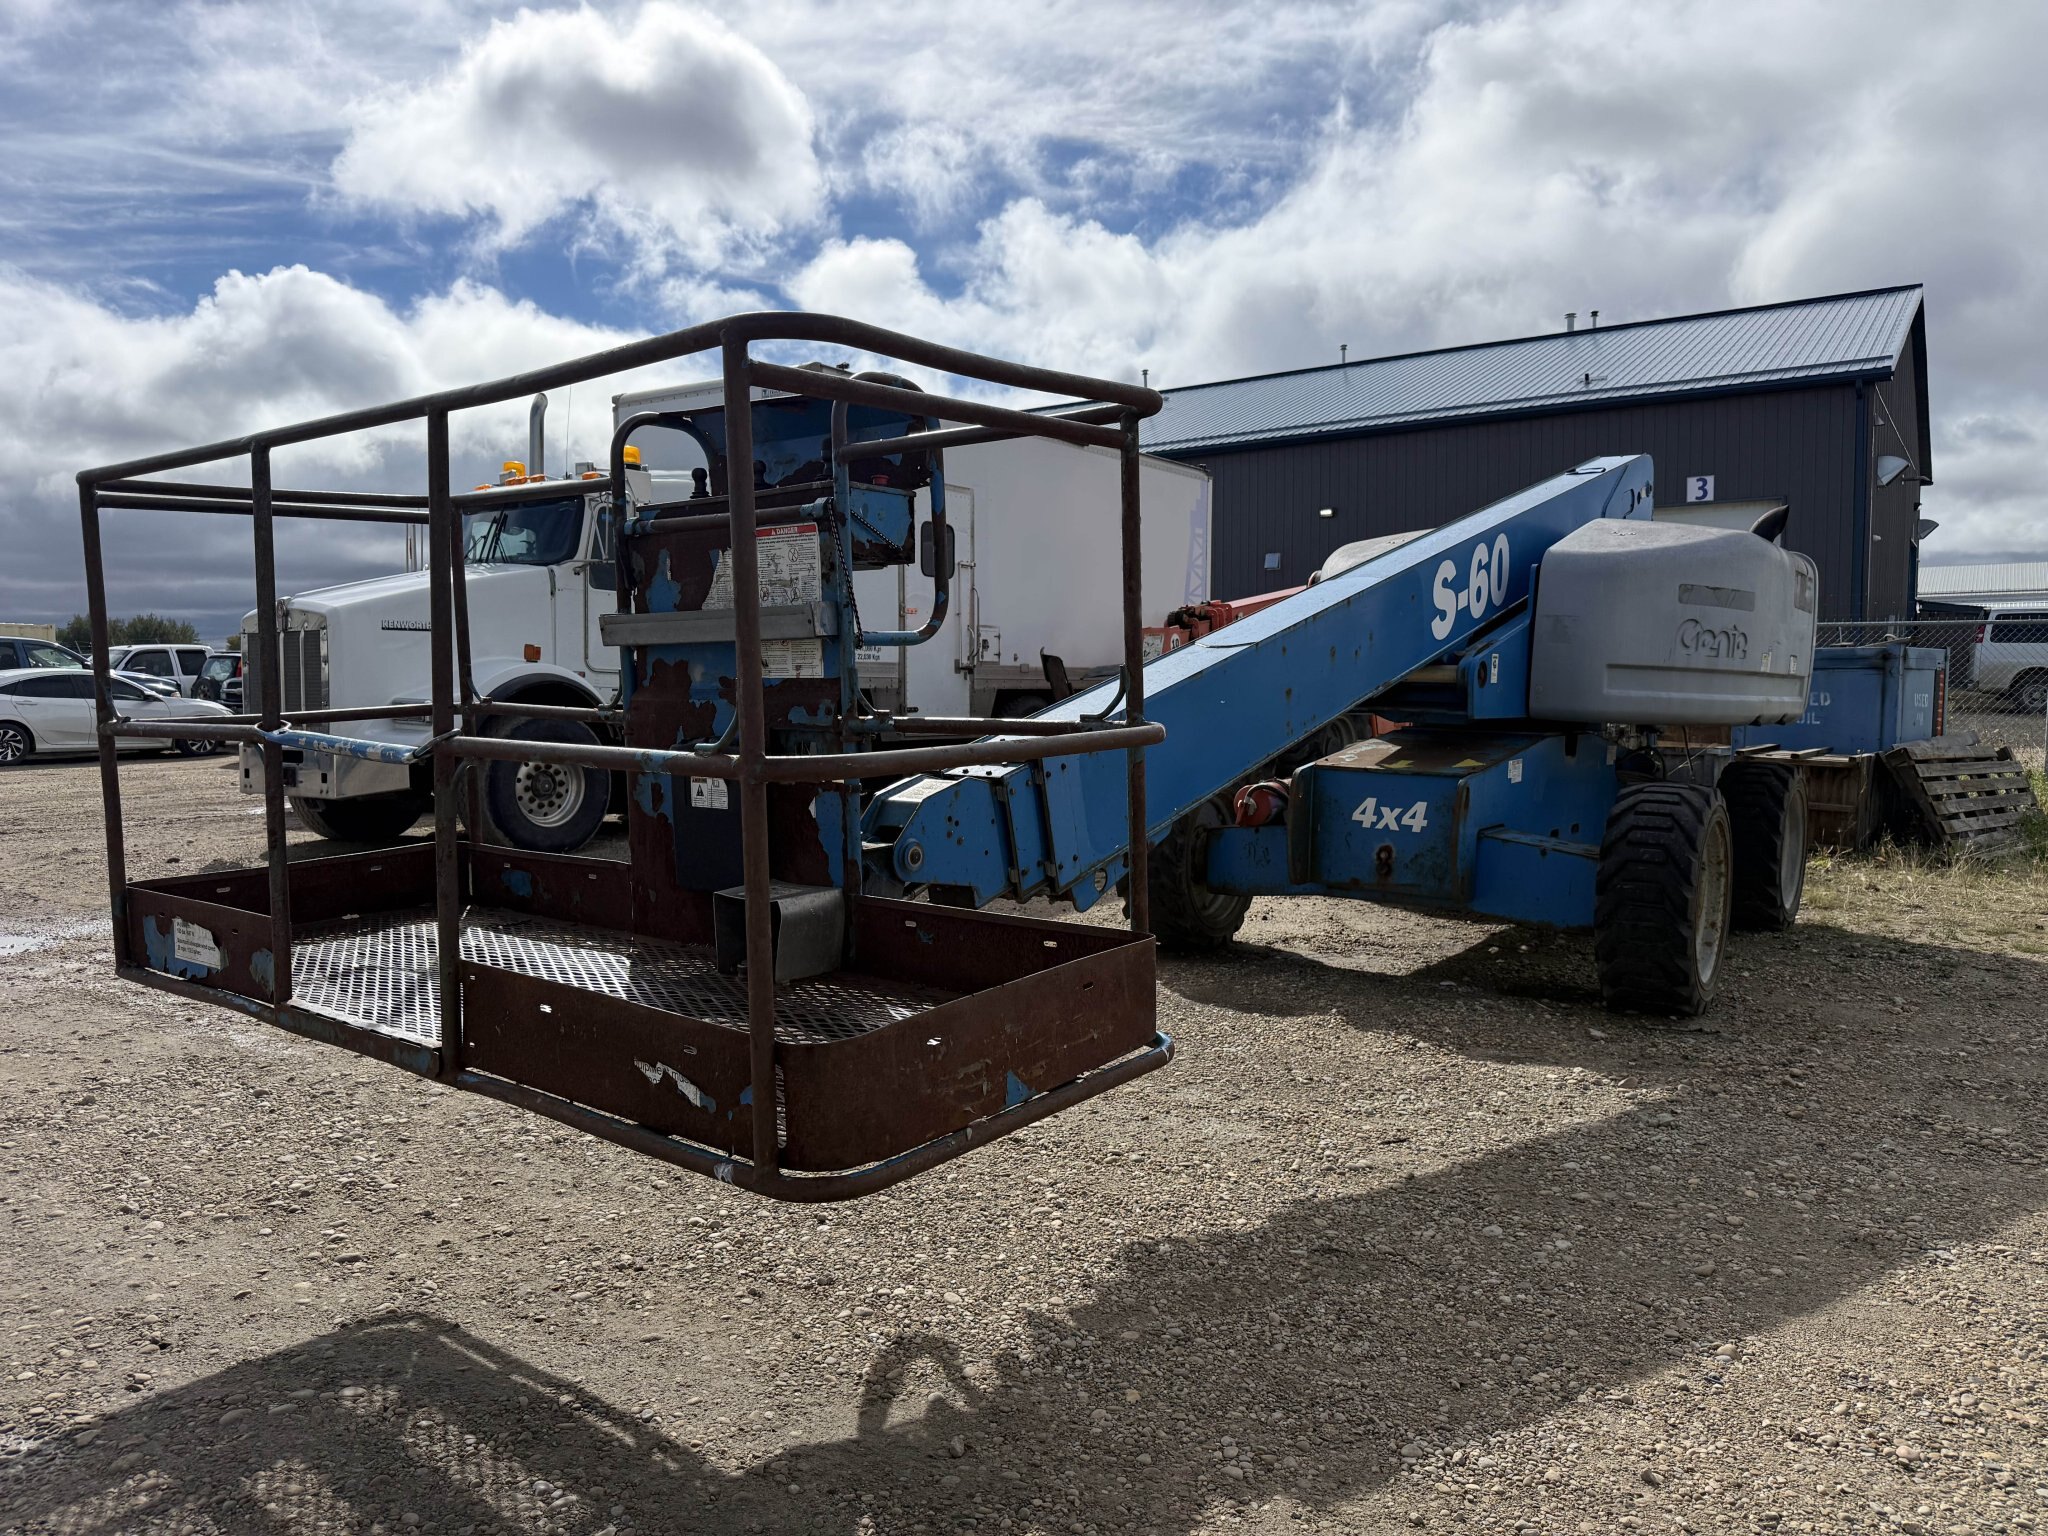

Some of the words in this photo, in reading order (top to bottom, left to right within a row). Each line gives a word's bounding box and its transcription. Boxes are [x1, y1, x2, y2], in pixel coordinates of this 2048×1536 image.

[1695, 477, 1708, 501] 3
[1431, 533, 1510, 641] S-60
[1676, 618, 1748, 660] Genie
[1810, 691, 1831, 706] ED
[1351, 797, 1428, 833] 4x4
